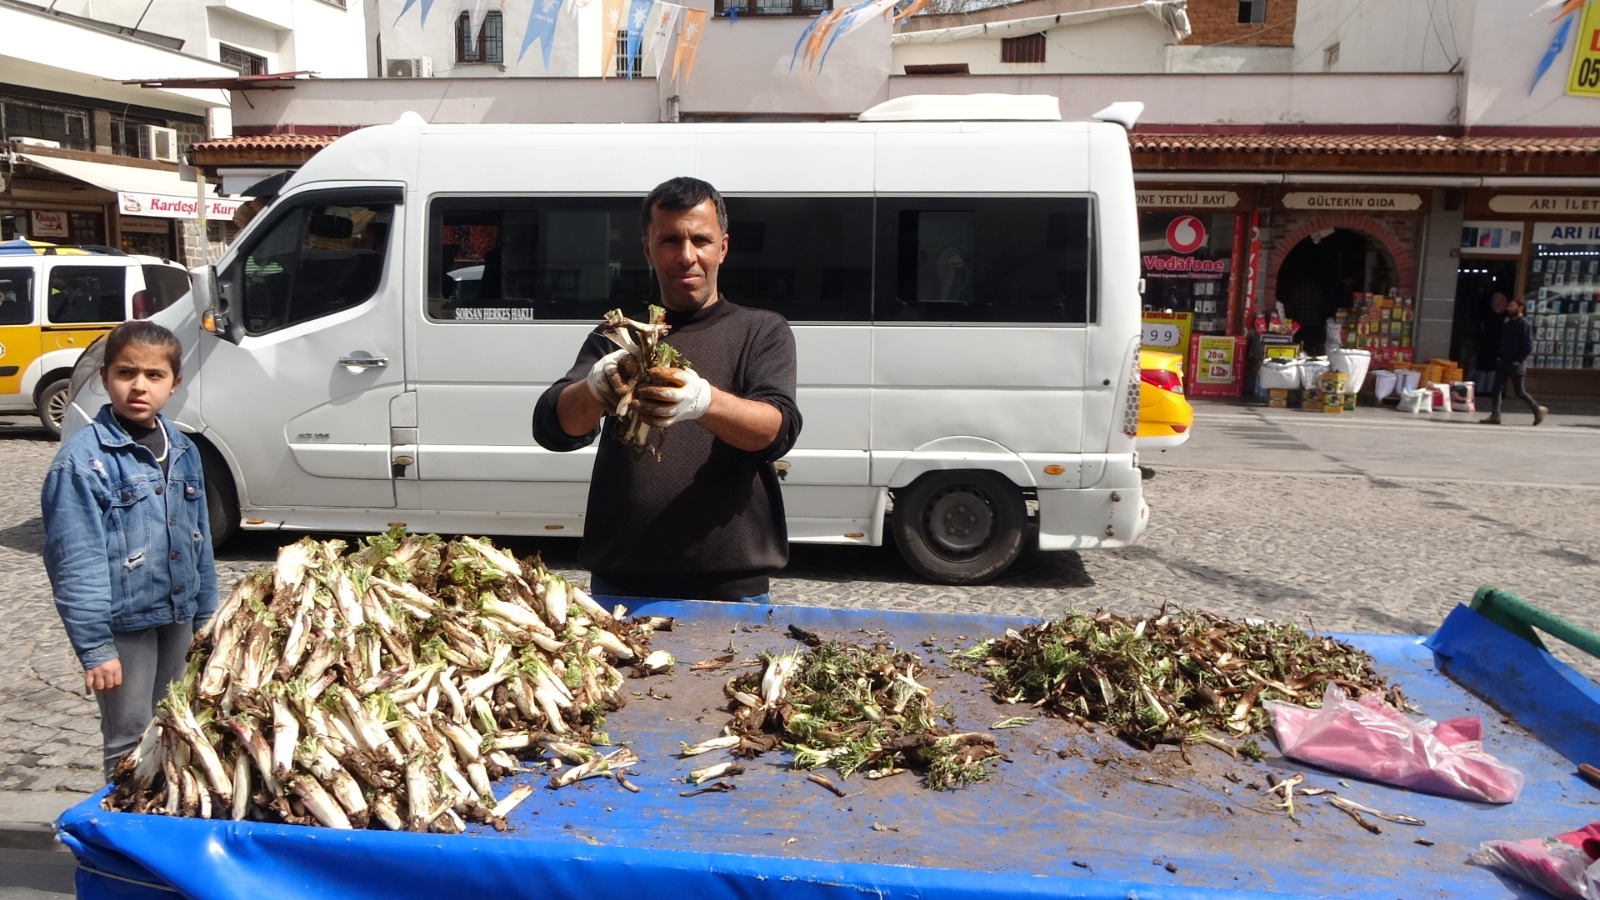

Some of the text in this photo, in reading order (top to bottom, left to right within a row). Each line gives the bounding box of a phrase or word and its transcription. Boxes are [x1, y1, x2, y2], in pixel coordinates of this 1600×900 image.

[1158, 193, 1198, 205] YETKİLİ
[1202, 193, 1226, 205] BAYİ
[1307, 195, 1395, 208] GÜLTEKİN GIDA
[1529, 199, 1556, 209] ARI
[150, 198, 210, 215] Kardeşlr
[1551, 226, 1583, 239] ARI
[1143, 255, 1224, 271] Vodafone
[455, 307, 534, 320] SORSAN HERKES HAKLI
